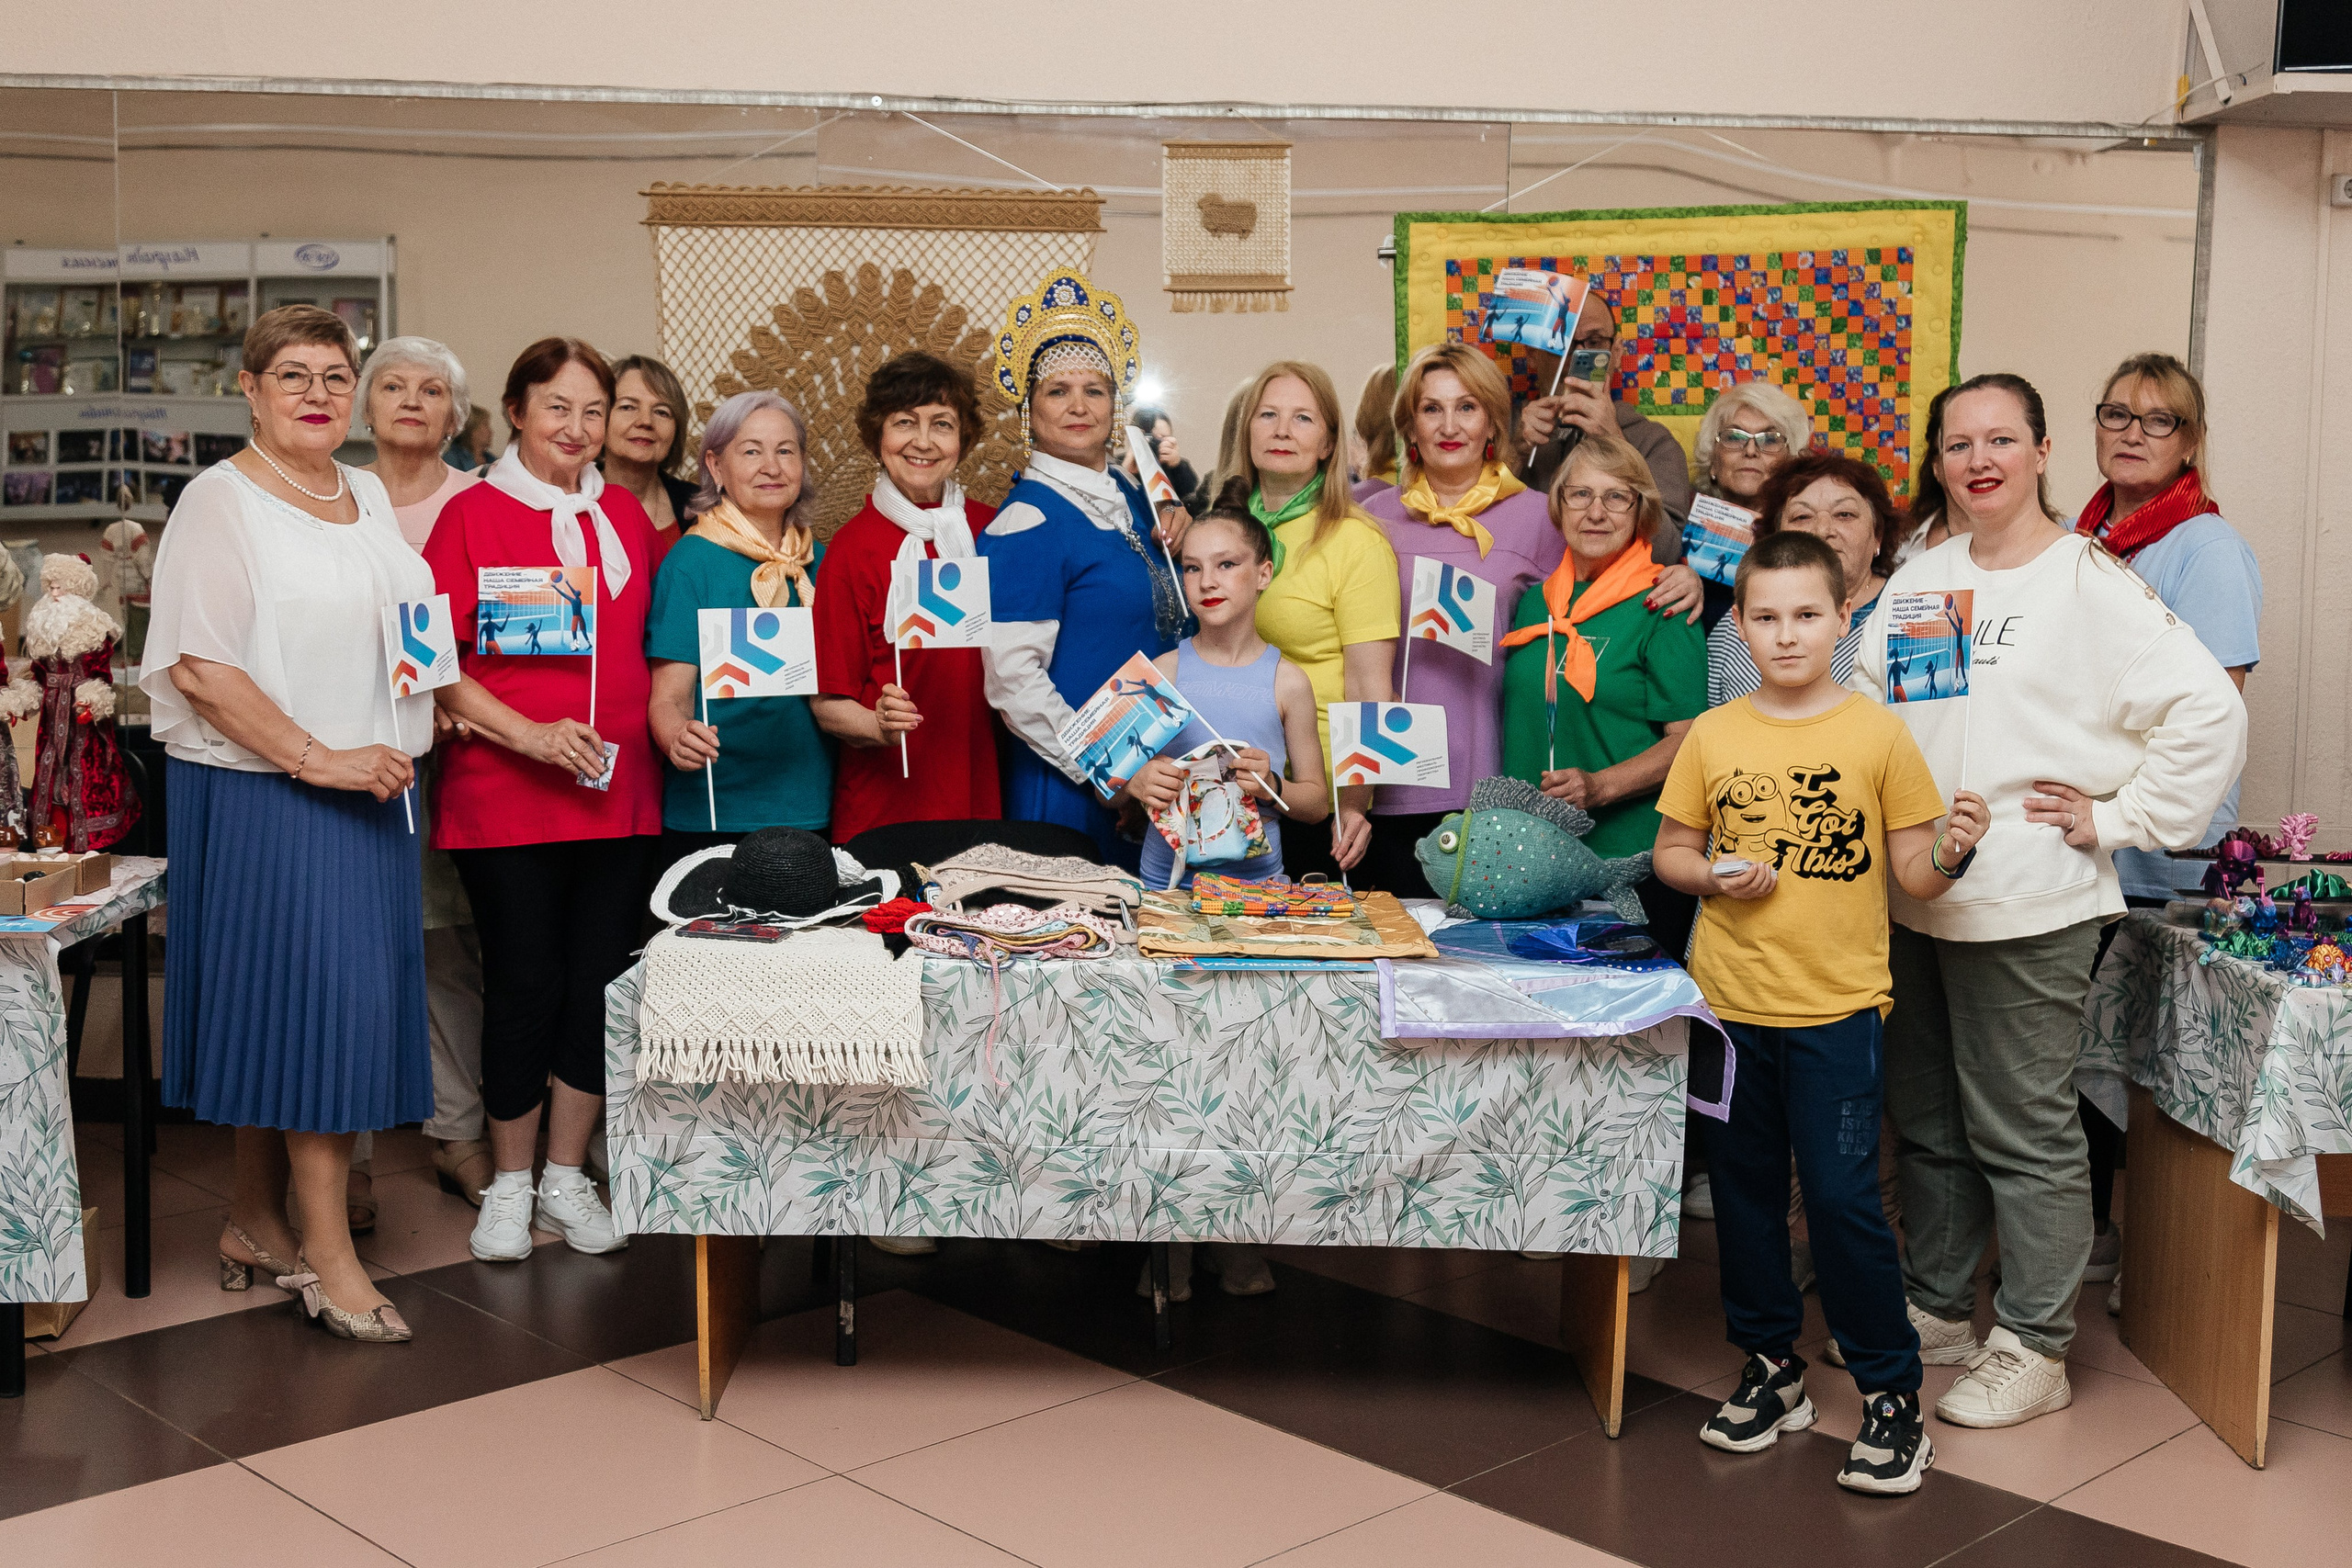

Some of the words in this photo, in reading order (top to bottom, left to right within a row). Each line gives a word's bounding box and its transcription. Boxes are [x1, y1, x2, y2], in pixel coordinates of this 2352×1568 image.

[1892, 613, 1922, 621] ТРАДИЦИЯ
[1910, 604, 1940, 612] СЕМЕЙНАЯ
[1787, 762, 1841, 799] I
[1789, 798, 1865, 840] Got
